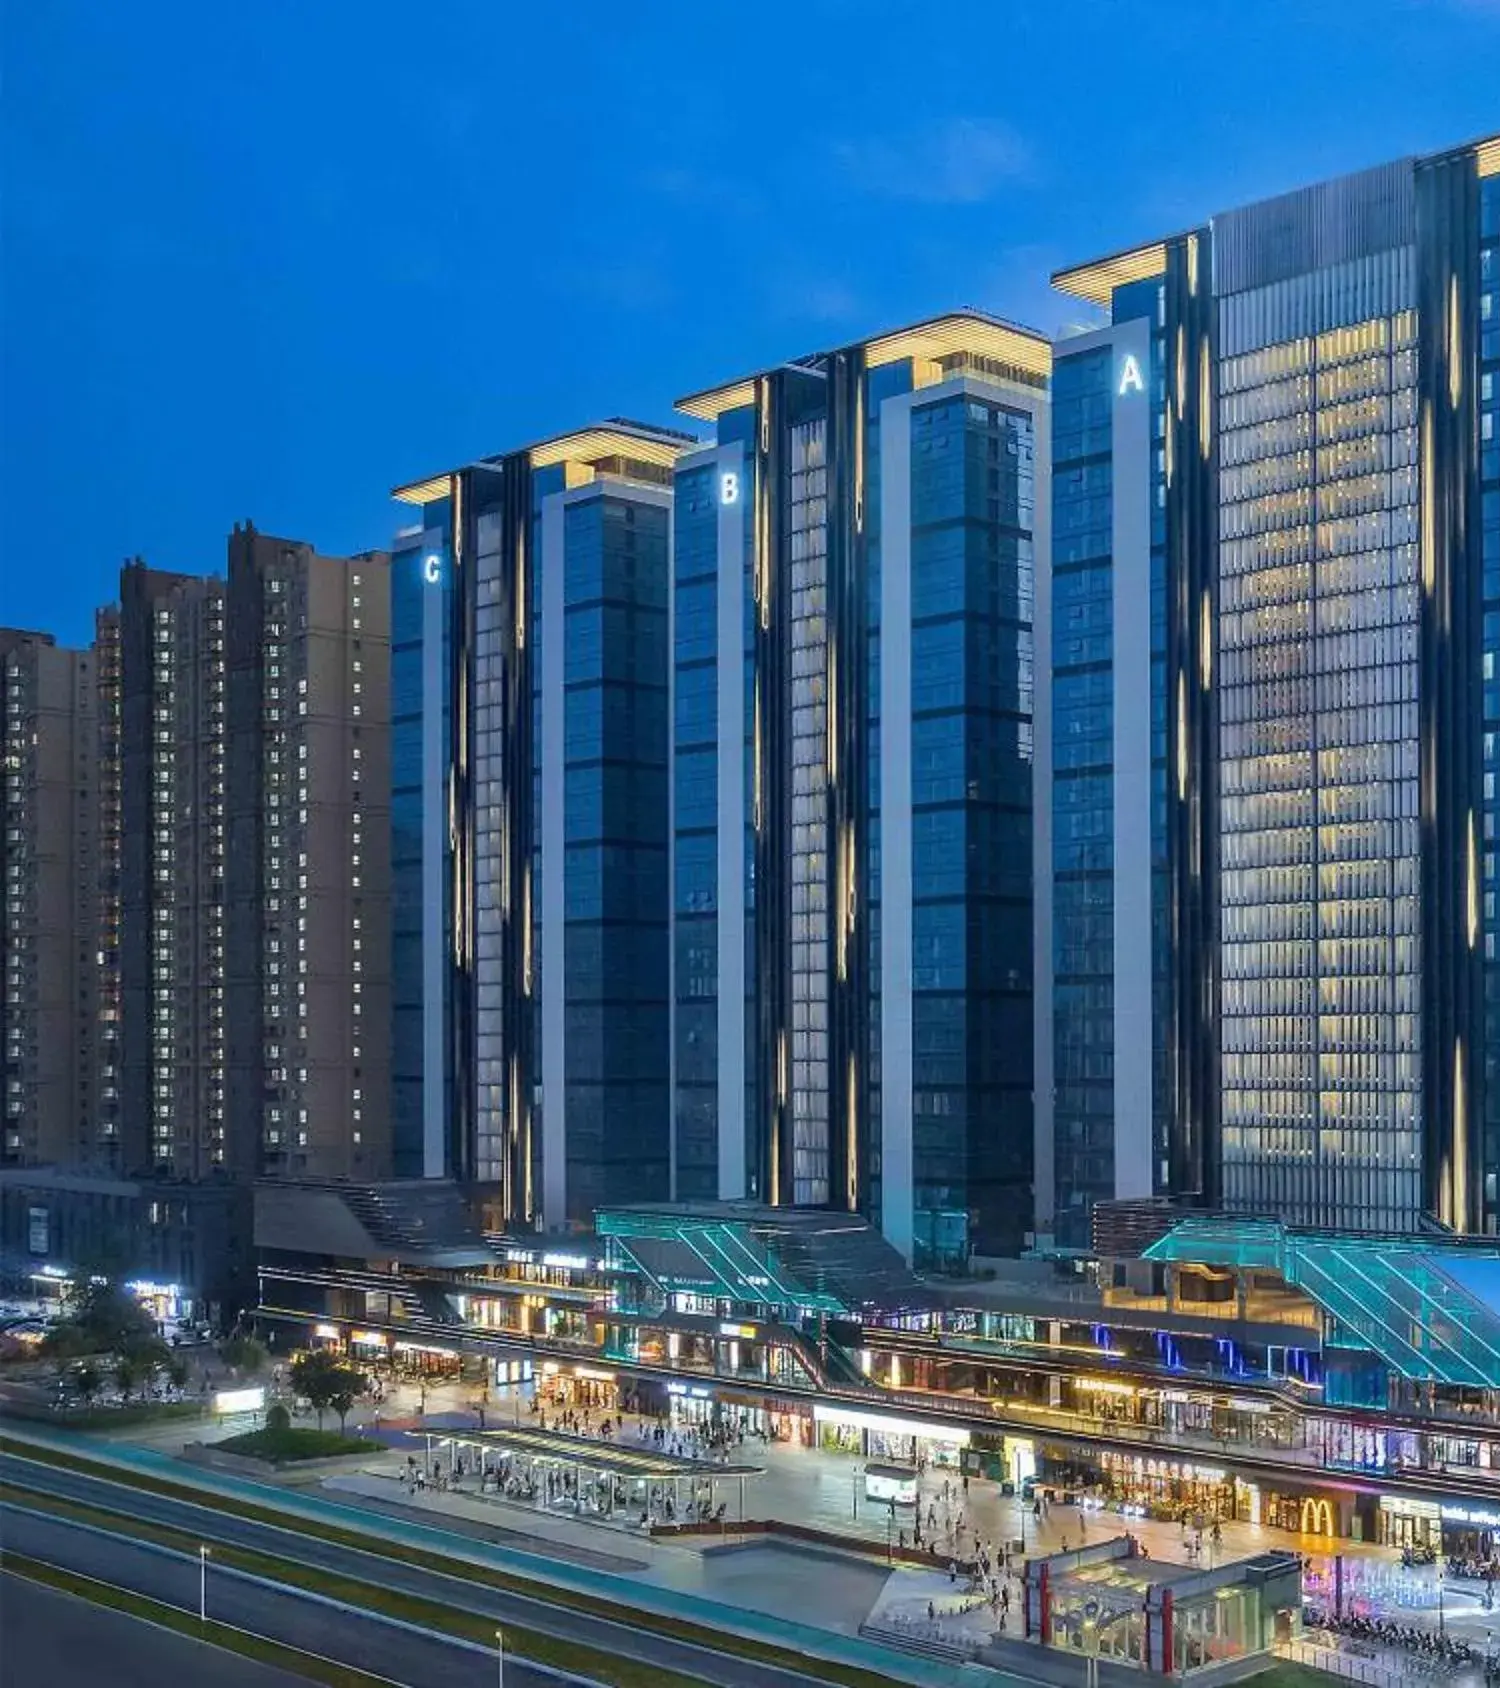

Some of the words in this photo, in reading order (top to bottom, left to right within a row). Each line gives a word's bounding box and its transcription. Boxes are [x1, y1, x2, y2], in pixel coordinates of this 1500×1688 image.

[1119, 355, 1143, 395] A
[721, 472, 739, 504] B
[425, 555, 440, 583] C
